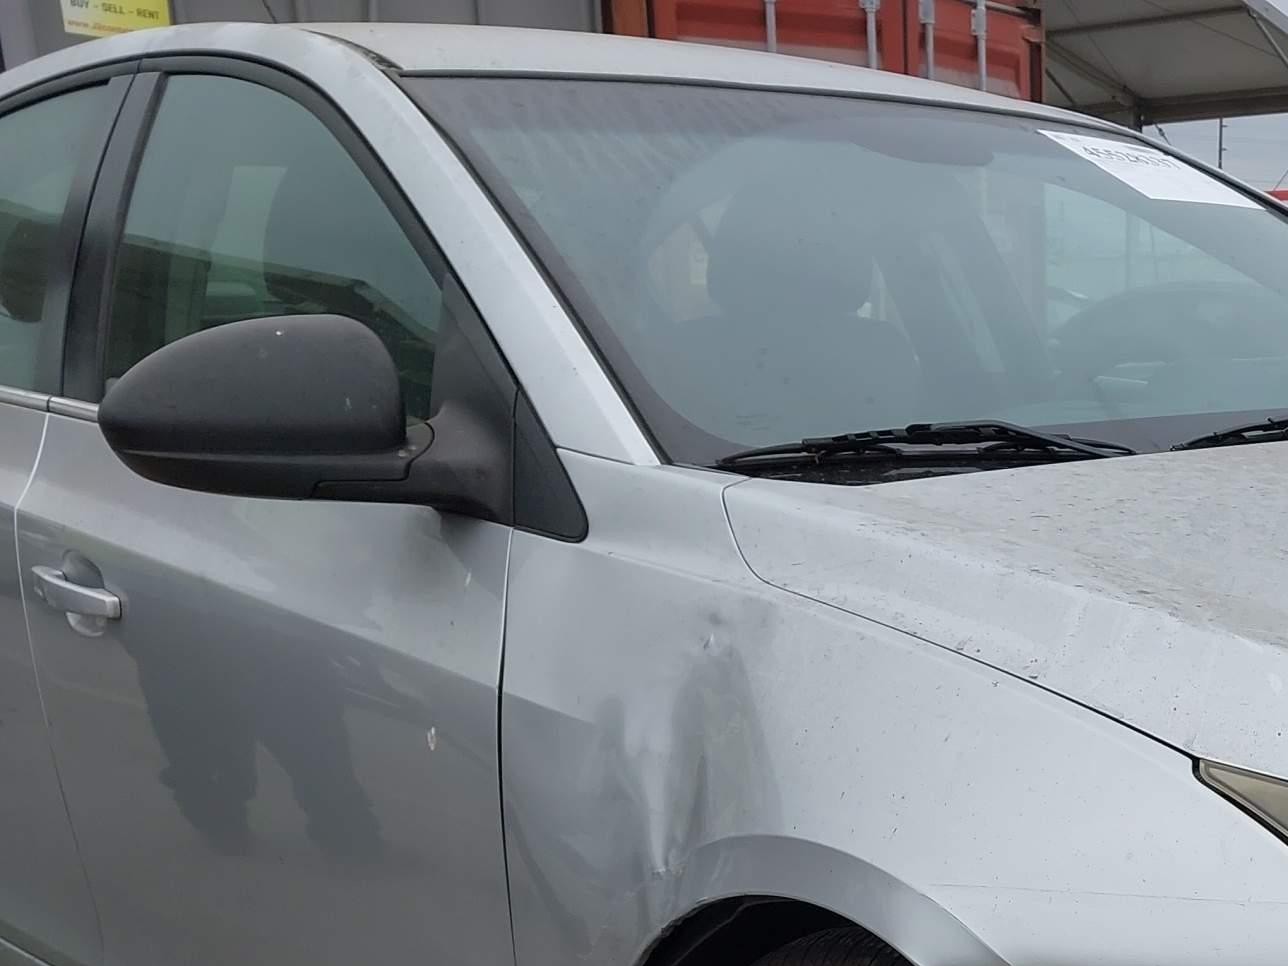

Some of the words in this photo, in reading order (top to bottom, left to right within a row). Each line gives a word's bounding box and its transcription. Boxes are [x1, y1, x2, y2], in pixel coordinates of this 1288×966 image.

[70, 0, 89, 8] BUY
[102, 2, 126, 14] SELL
[136, 7, 160, 20] RENT
